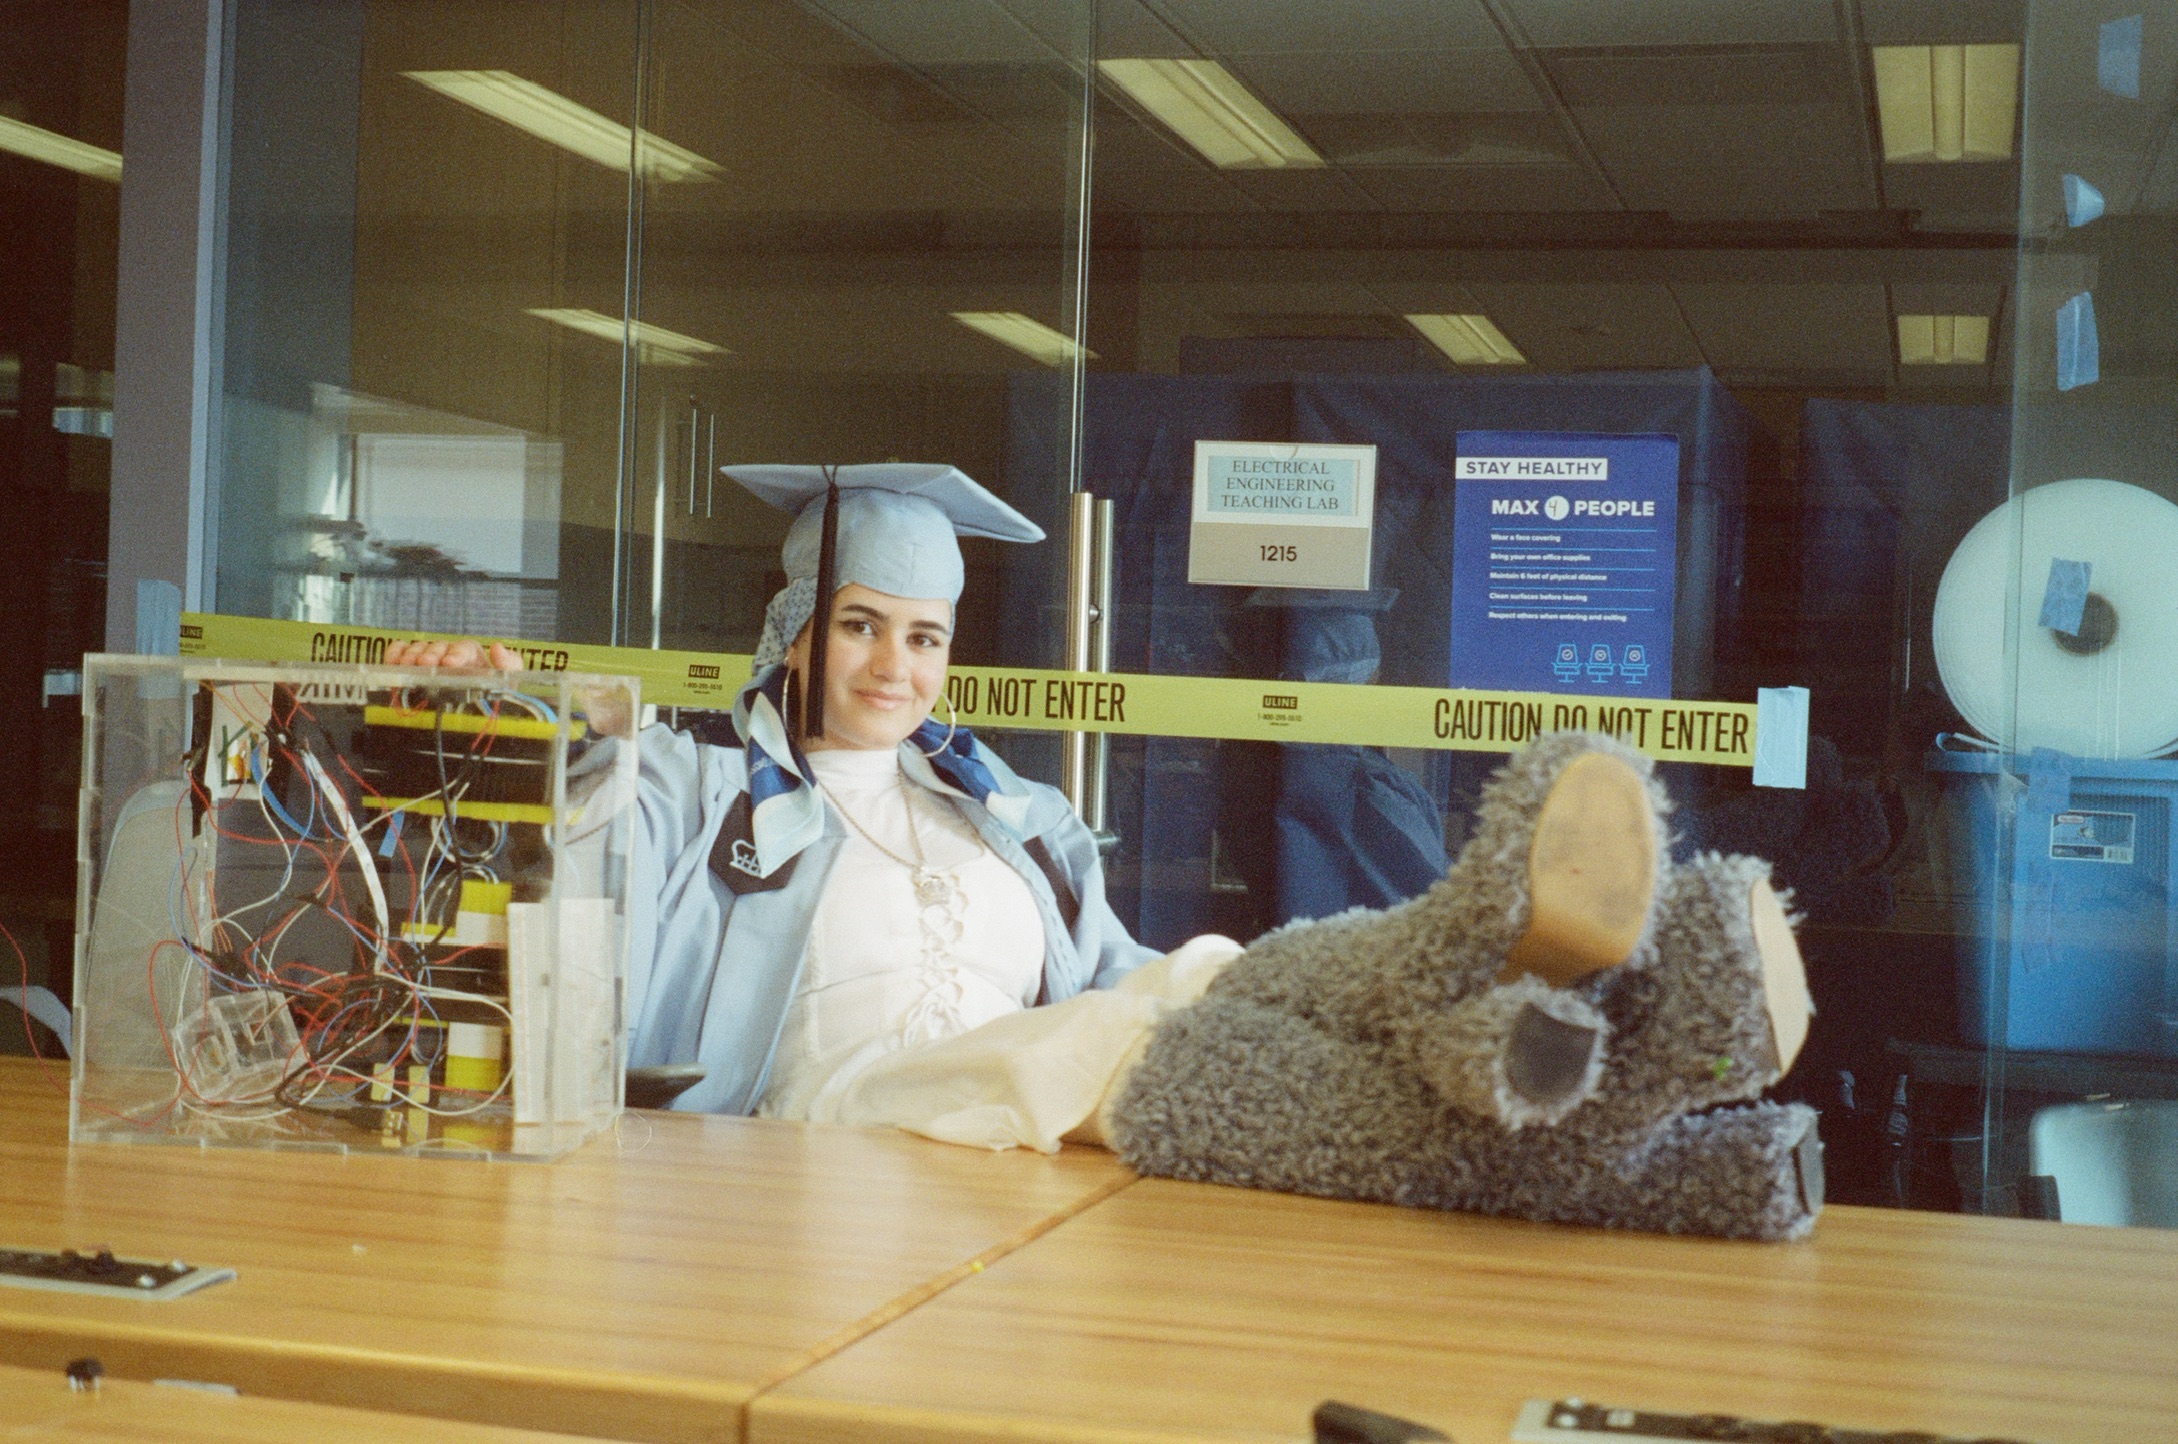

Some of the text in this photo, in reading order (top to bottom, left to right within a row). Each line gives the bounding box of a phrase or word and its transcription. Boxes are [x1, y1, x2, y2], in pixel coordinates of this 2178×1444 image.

[1233, 460, 1330, 474] ELECTRICAL
[1466, 462, 1602, 475] STAY HEALTHY
[1226, 478, 1335, 492] ENGINEERING
[1221, 495, 1338, 510] TEACHING LAB
[1492, 500, 1539, 515] MAX
[1574, 501, 1655, 516] PEOPLE
[1260, 546, 1298, 562] 1215
[1490, 553, 1509, 561] Bring
[1488, 612, 1516, 620] Respect
[690, 666, 719, 678] ULINE
[946, 676, 1126, 722] DO NOT ENTER
[1264, 697, 1296, 708] ULINE
[1434, 698, 1749, 754] CAUTION DO NOT ENTER
